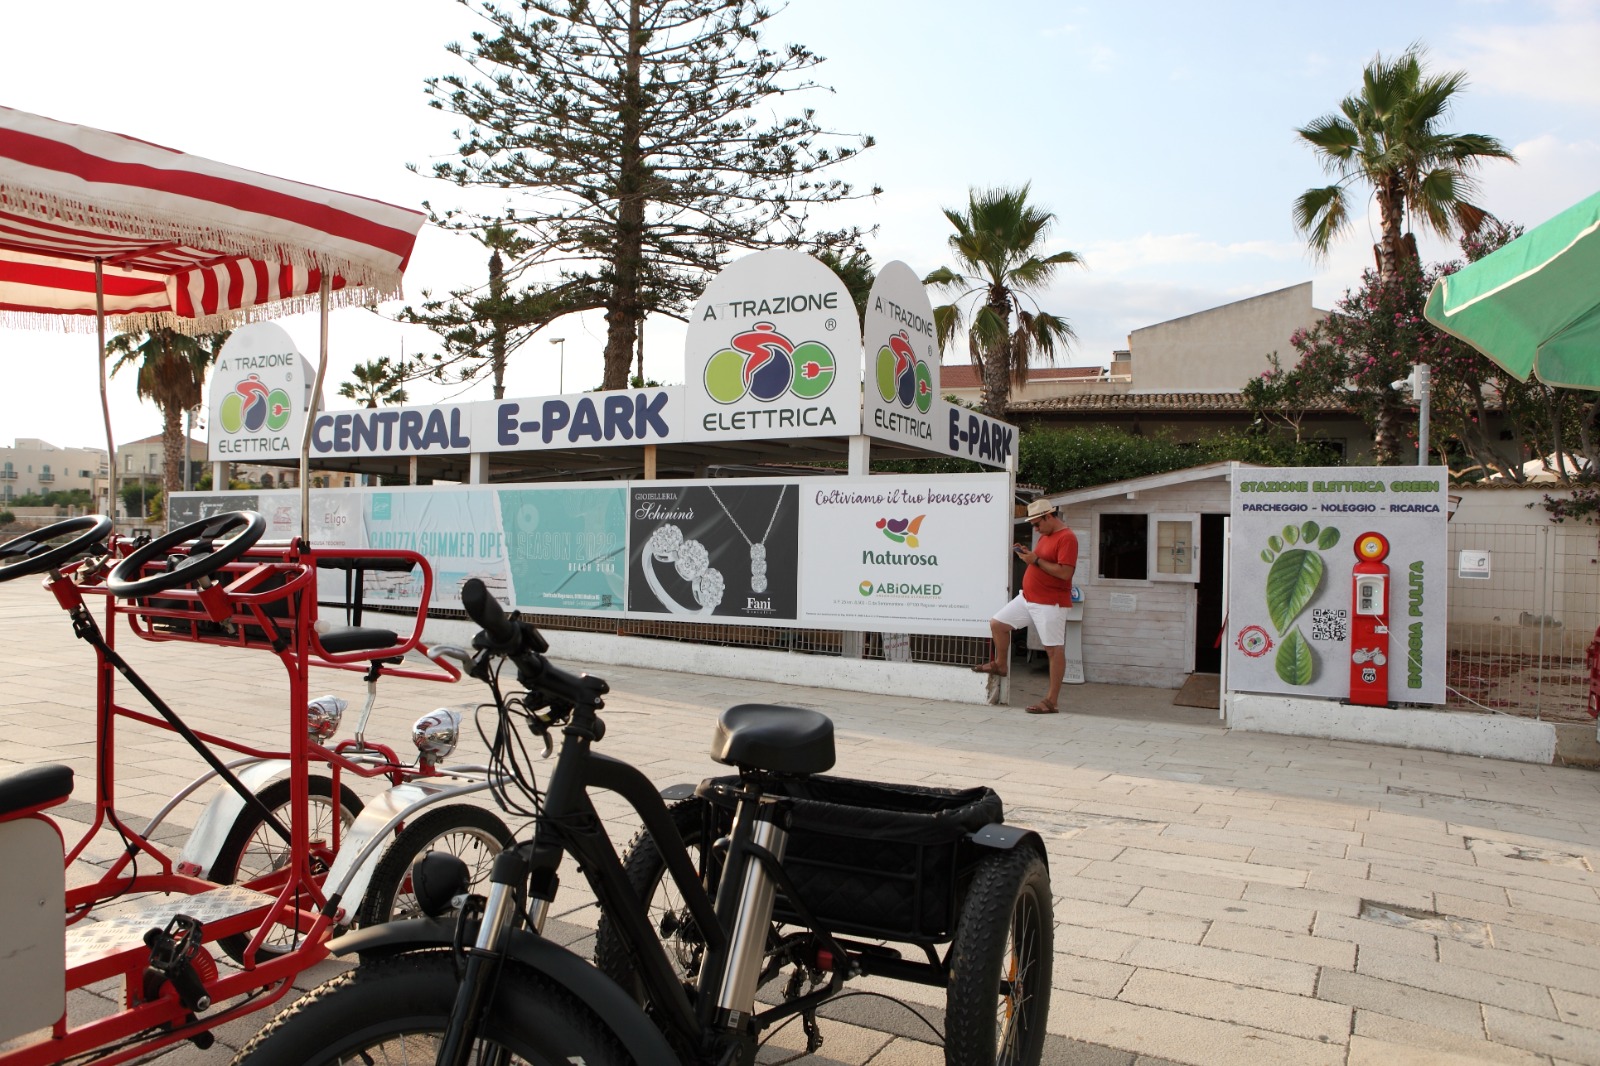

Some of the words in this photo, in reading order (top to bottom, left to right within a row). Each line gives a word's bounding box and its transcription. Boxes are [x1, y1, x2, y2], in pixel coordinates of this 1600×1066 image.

[312, 407, 471, 453] CENTRAL
[497, 391, 669, 446] E-PARK
[702, 406, 837, 432] ELETTRICA
[874, 408, 932, 441] ELETTRICA
[218, 437, 290, 453] ELETTRICA
[949, 408, 1013, 464] E-PARK
[635, 492, 678, 501] GIOIELLERIA
[1240, 481, 1309, 493] STAZIONE
[1312, 481, 1386, 493] ELETTRICA
[1390, 481, 1440, 493] GREEN
[815, 489, 886, 506] Coltiviamo
[886, 489, 900, 504] il
[900, 489, 925, 504] tuo
[927, 488, 994, 506] benessere
[634, 501, 695, 520] Schininà
[1242, 503, 1308, 512] PARCHEGGIO
[1321, 504, 1376, 512] NOLEGGIO
[1390, 504, 1440, 513] RICARICA
[324, 511, 347, 526] Eligo
[420, 531, 475, 558] SUMMER
[517, 532, 571, 561] SEASON
[1408, 560, 1424, 617] PULITA
[746, 597, 772, 610] Fani
[1407, 621, 1424, 689] ENERGIA
